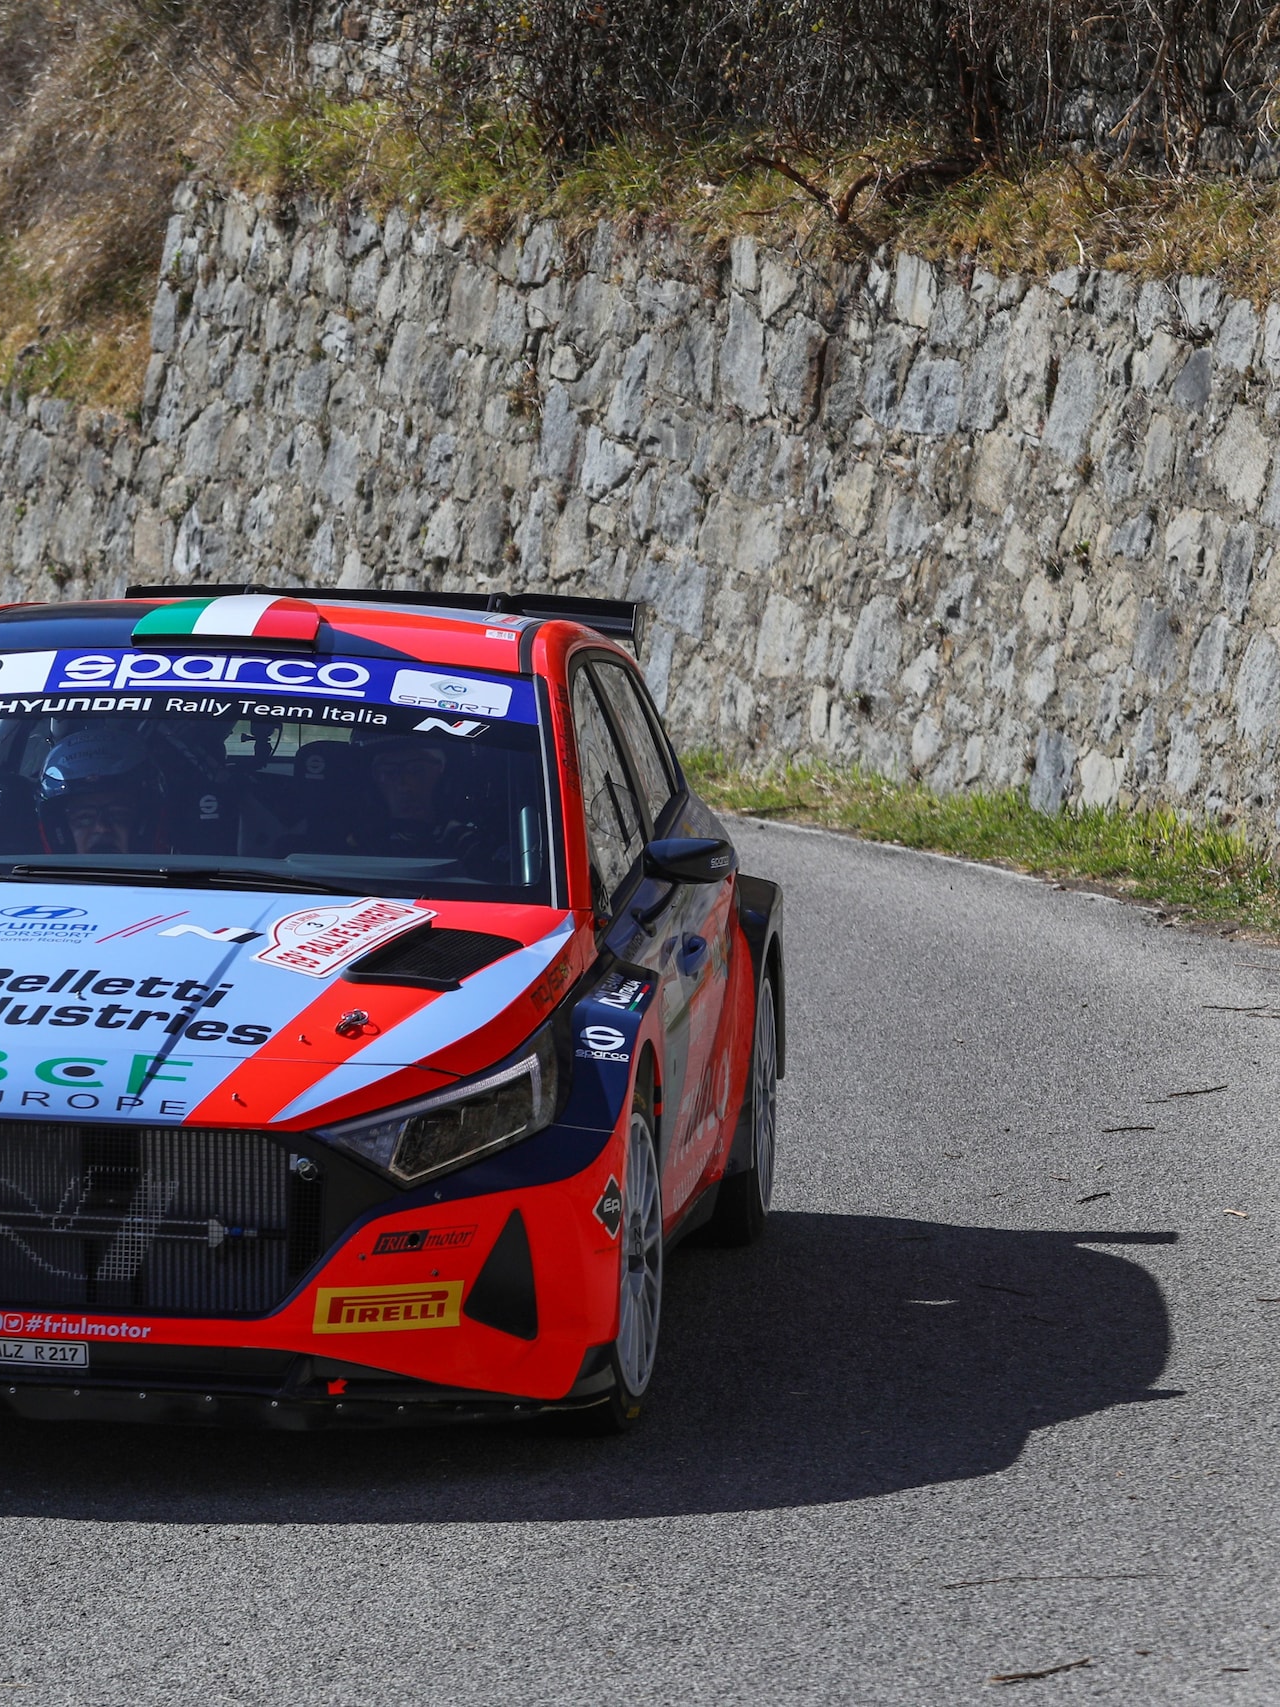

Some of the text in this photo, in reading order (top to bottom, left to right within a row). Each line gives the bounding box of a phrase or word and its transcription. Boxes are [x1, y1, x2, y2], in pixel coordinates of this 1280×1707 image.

[59, 653, 370, 697] sparco
[443, 684, 467, 694] ACI
[165, 698, 232, 717] Rally
[237, 700, 313, 719] Team
[321, 705, 387, 725] Italia
[397, 694, 500, 715] SPORT
[296, 928, 361, 957] RALLYE
[341, 903, 415, 932] SANREMO
[575, 1049, 629, 1062] sparco
[425, 1230, 473, 1247] motor
[327, 1290, 449, 1324] PIRELLI
[25, 1314, 151, 1338] #friulmotor
